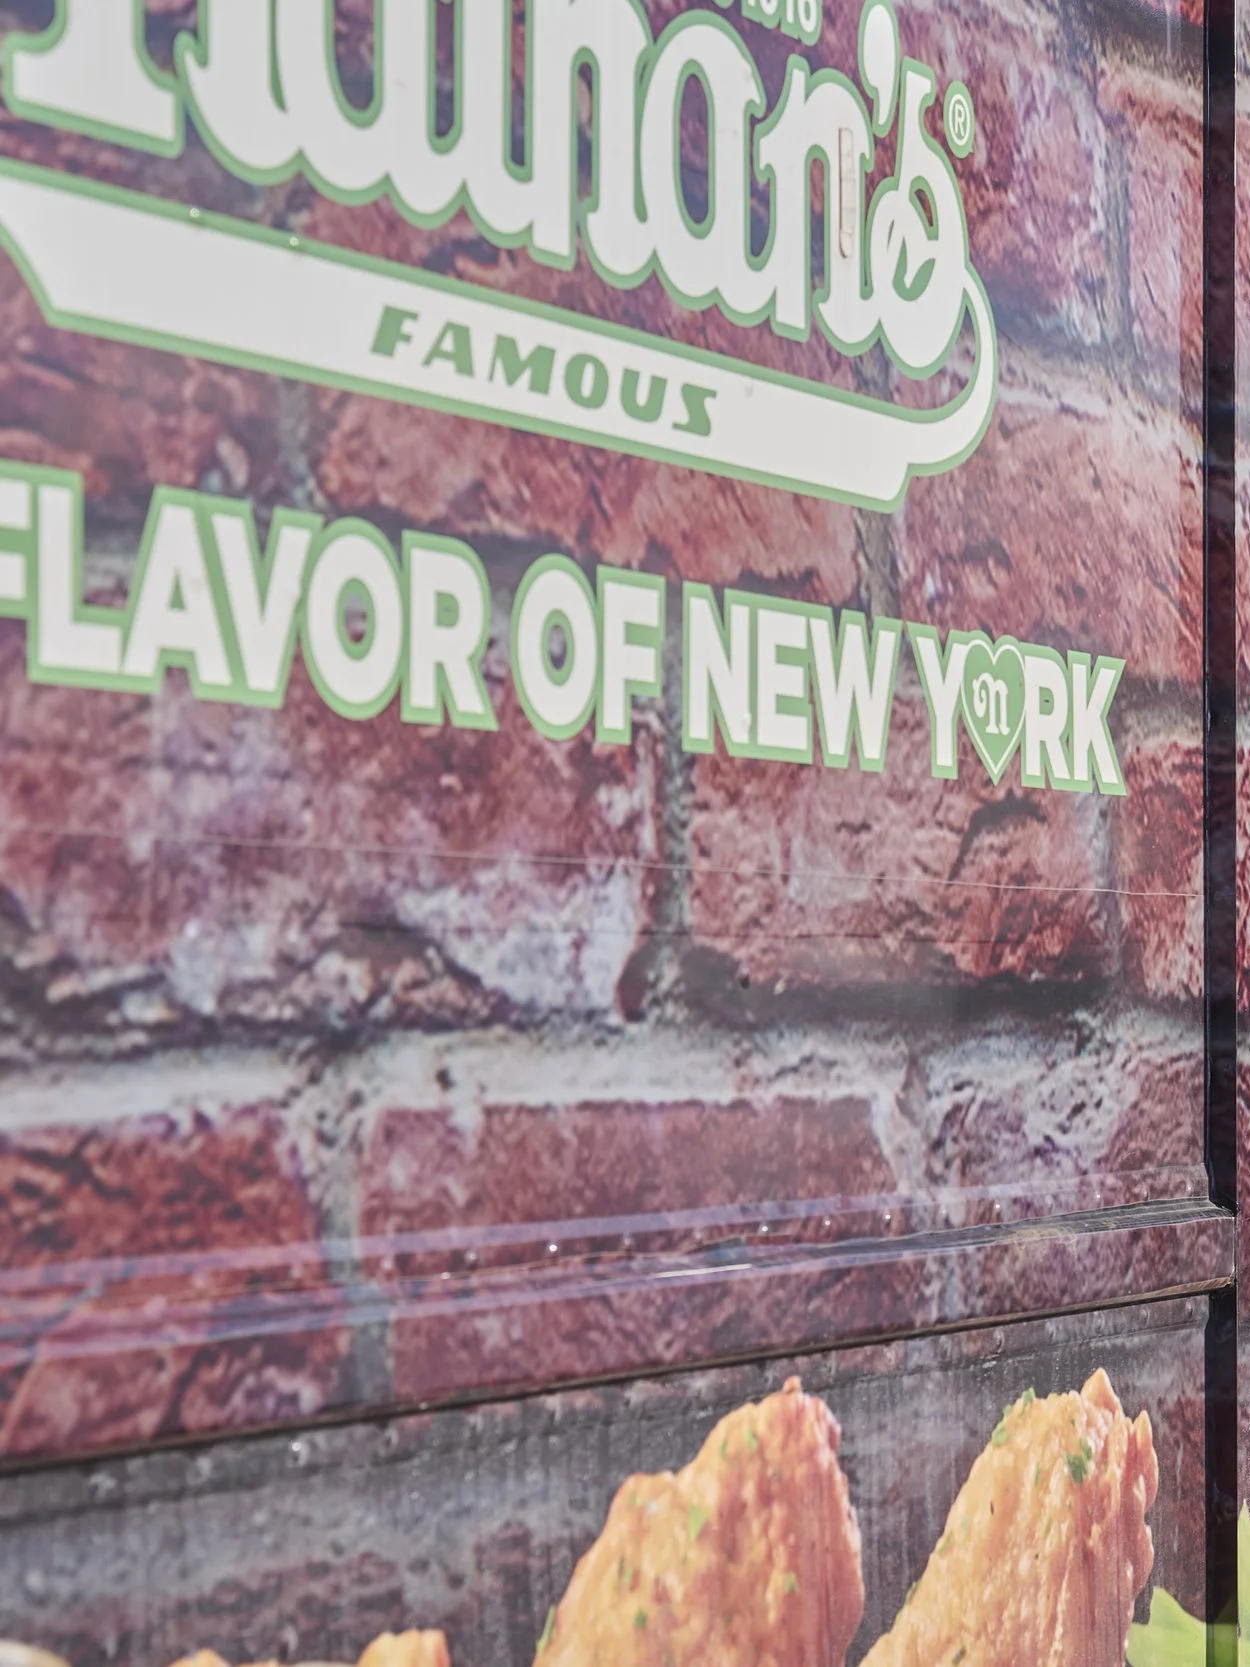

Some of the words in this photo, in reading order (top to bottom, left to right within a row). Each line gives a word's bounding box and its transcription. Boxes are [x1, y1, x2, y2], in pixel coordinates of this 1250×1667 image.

[370, 305, 718, 437] FAMOUS
[517, 568, 661, 729] OF
[688, 594, 898, 762] NEW
